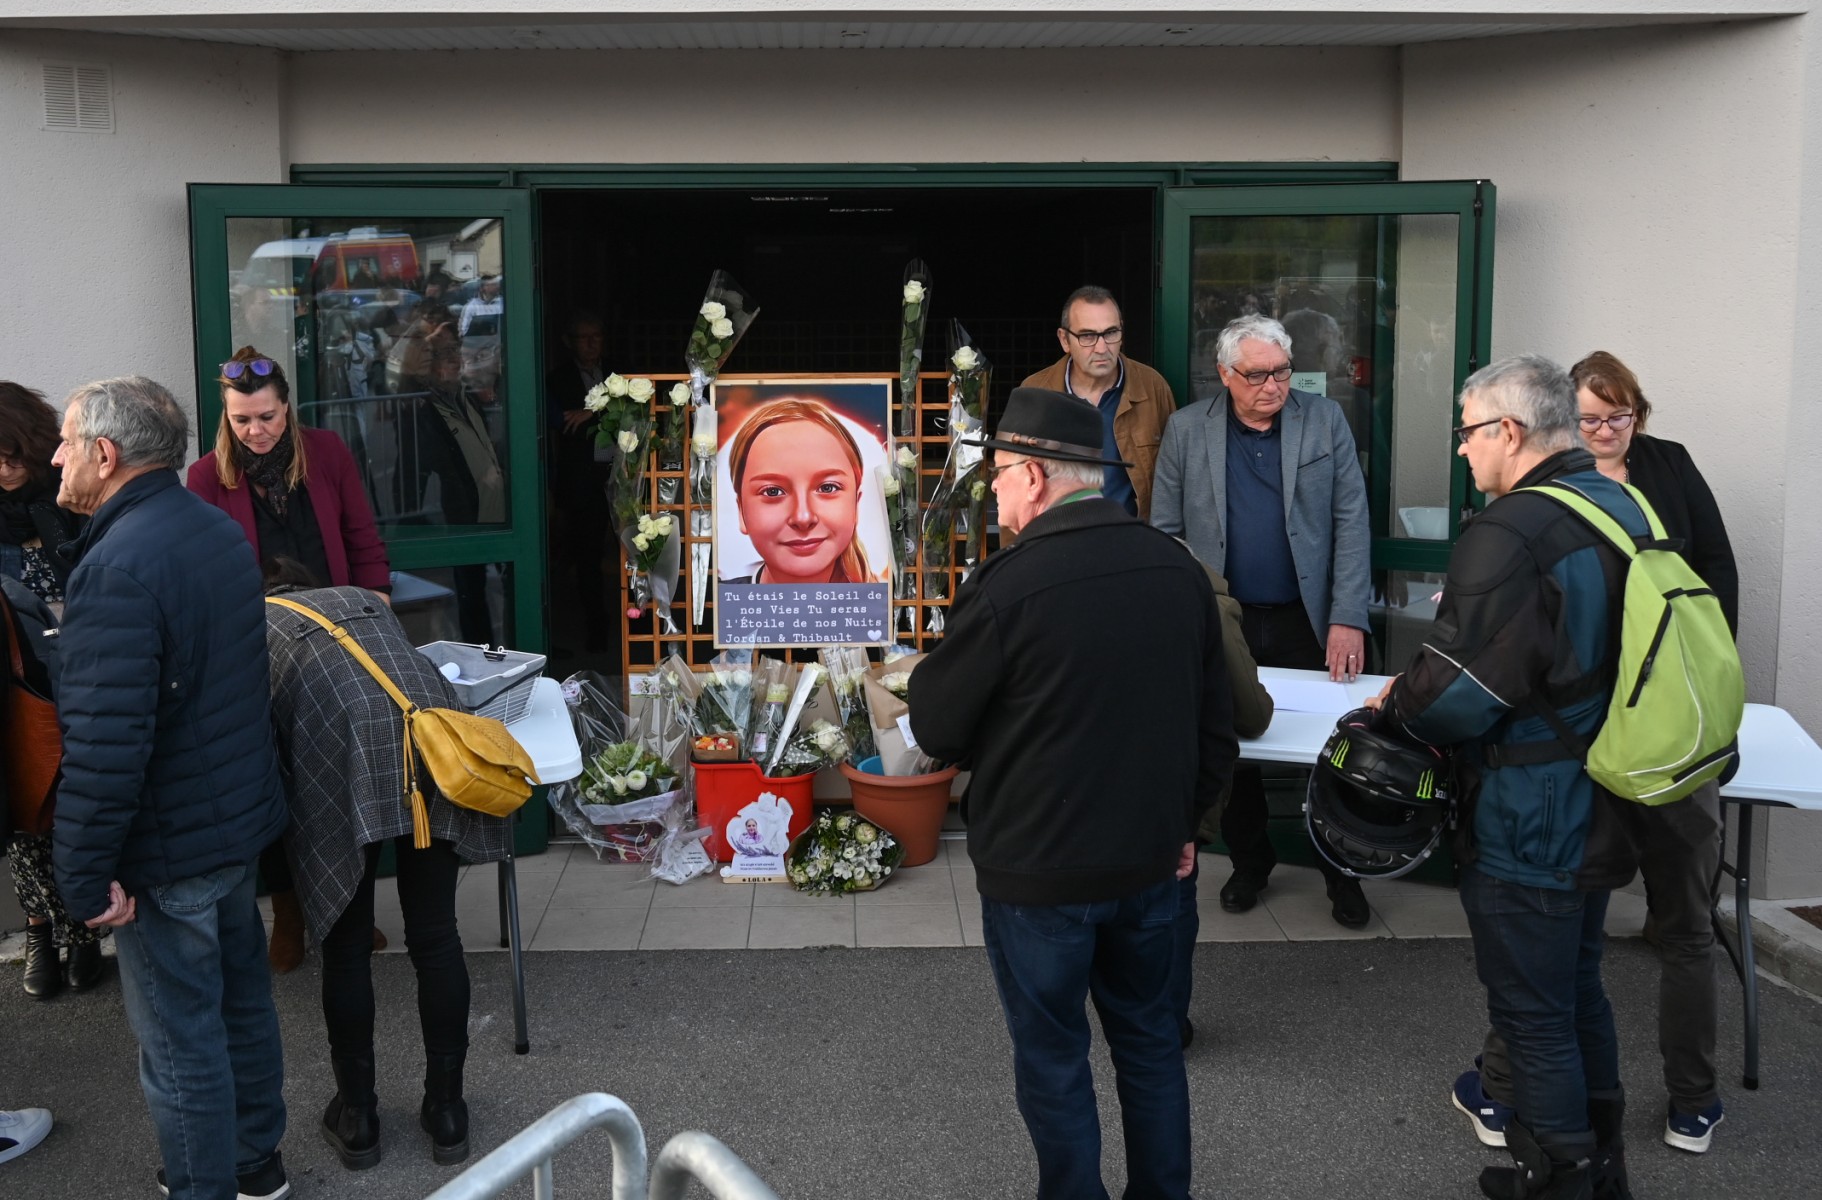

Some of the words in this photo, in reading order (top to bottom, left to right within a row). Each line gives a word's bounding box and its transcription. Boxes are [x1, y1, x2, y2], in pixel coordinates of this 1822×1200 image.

[724, 592, 741, 602] Tu
[747, 591, 784, 601] étais
[792, 591, 807, 601] le
[815, 591, 860, 601] Soleil
[867, 591, 882, 600] de
[770, 605, 800, 614] Vies
[807, 604, 823, 614] Tu
[830, 606, 867, 614] seras
[725, 616, 785, 629] l'Étoile
[792, 619, 807, 628] de
[815, 620, 837, 628] nos
[844, 617, 882, 627] Nuits
[725, 633, 771, 643] Jordan
[778, 633, 786, 643] &
[792, 632, 852, 642] Thibault
